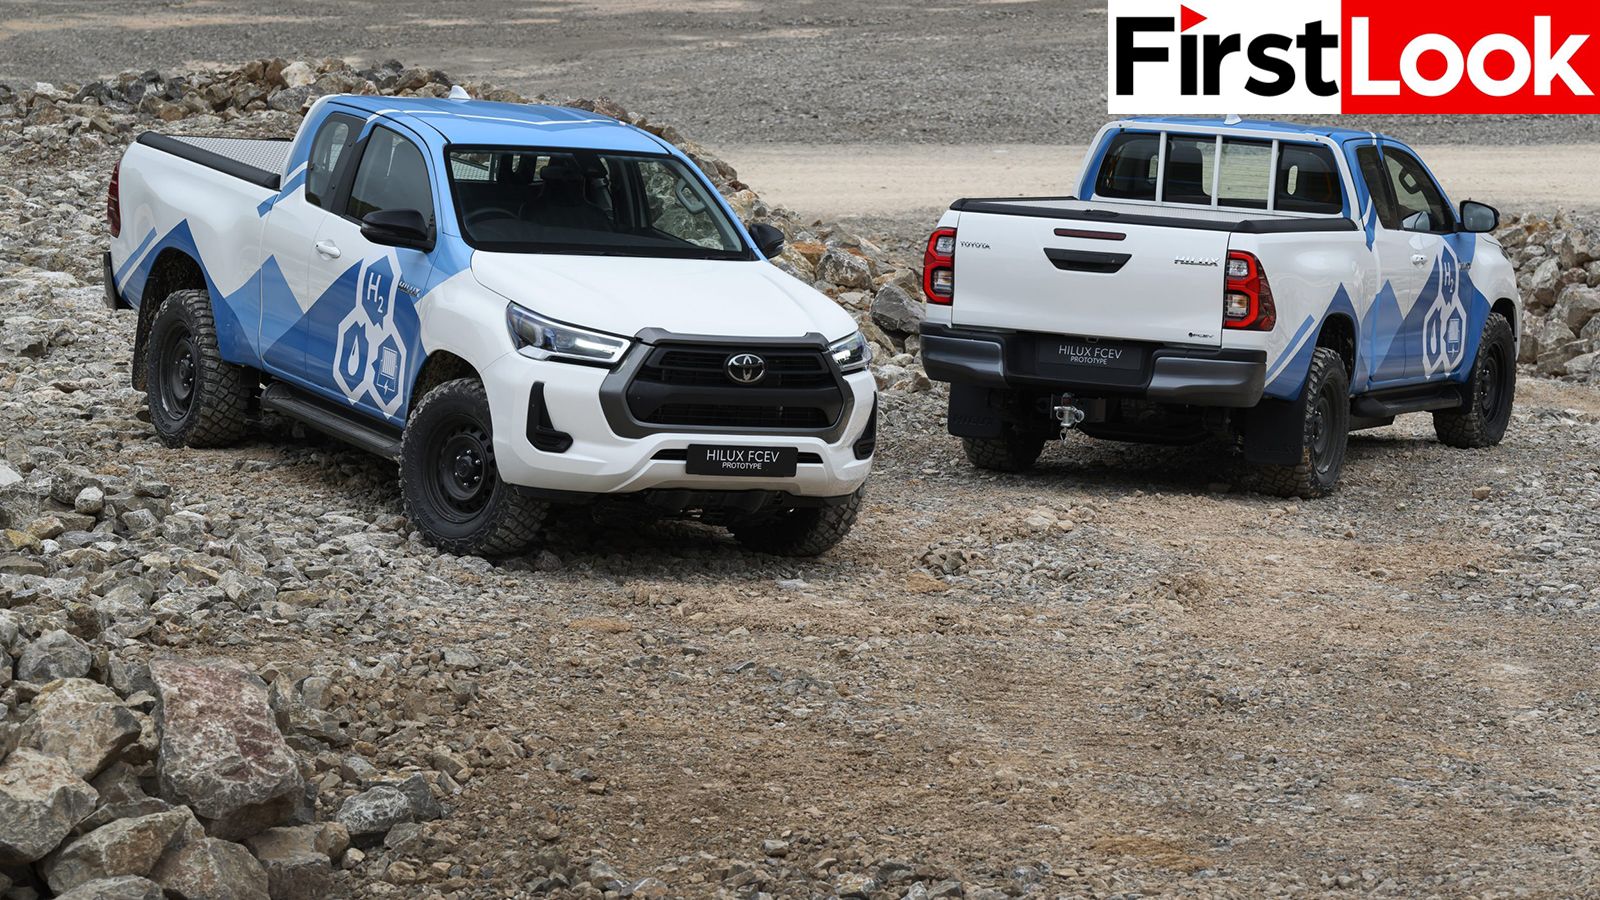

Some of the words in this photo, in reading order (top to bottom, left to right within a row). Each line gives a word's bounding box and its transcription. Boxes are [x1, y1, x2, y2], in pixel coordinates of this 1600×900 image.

[960, 241, 991, 250] TOYOTA
[1173, 256, 1219, 267] HILUX
[1059, 345, 1092, 357] HILUX
[1094, 348, 1122, 359] FCEV
[1070, 356, 1107, 365] PROTOTYPE
[706, 449, 744, 461] HILUX
[748, 451, 779, 462] FCEV
